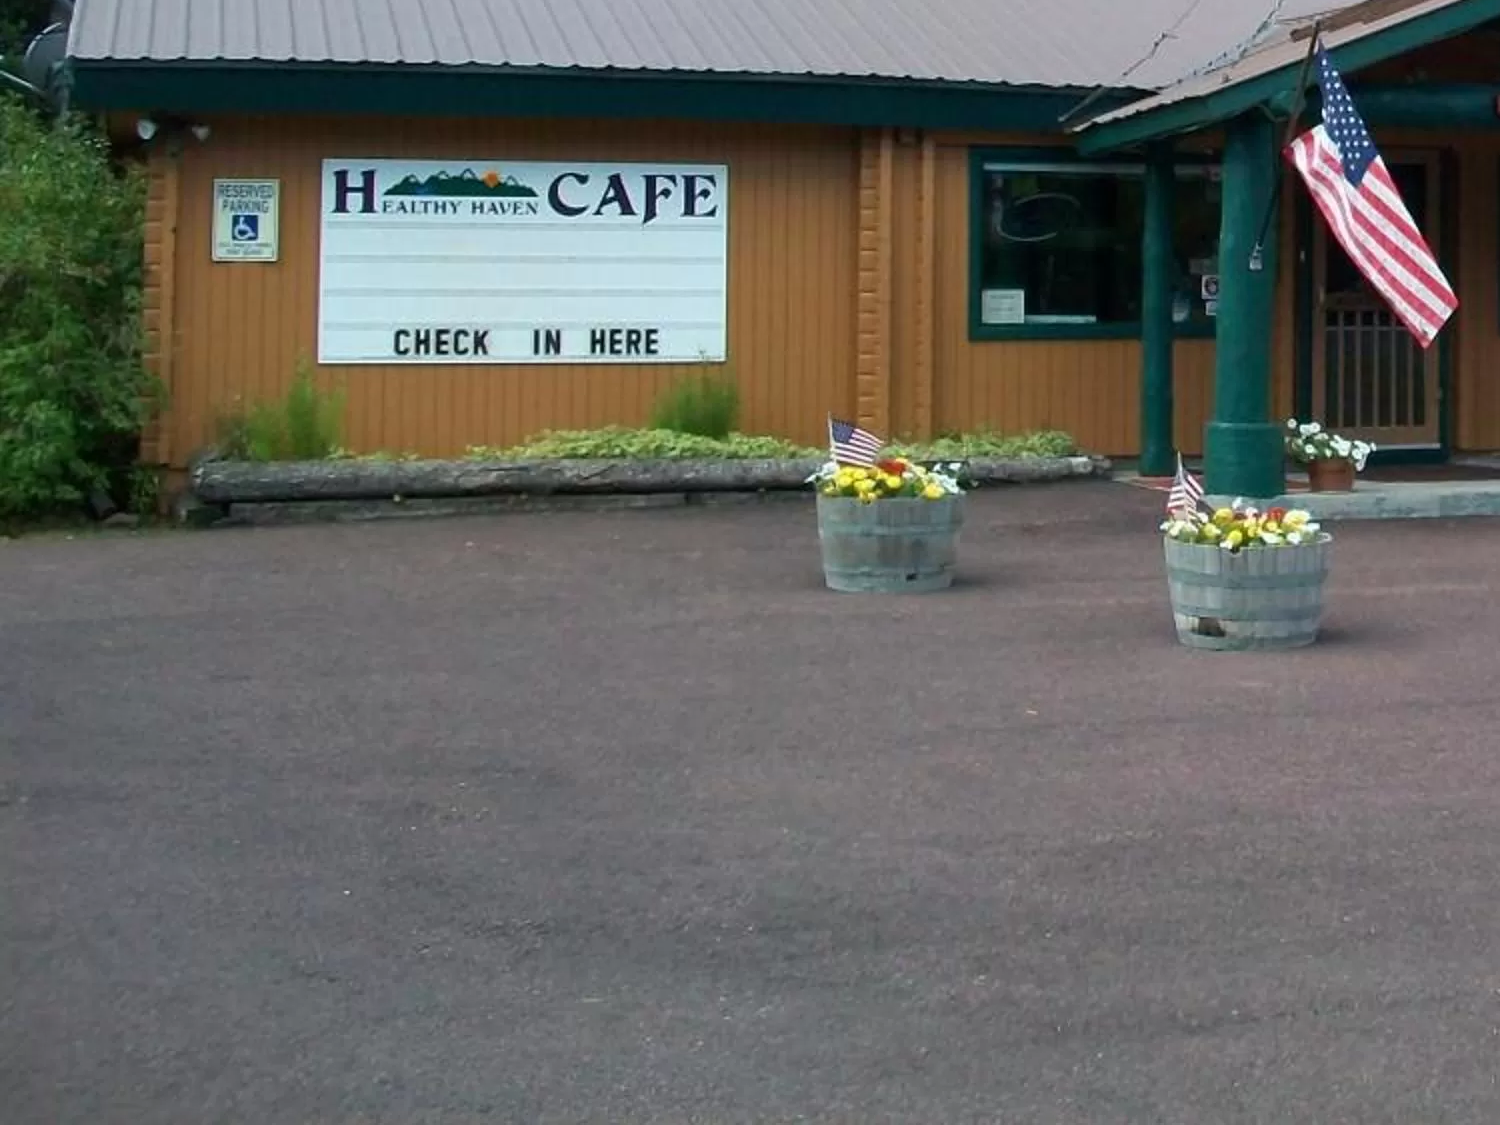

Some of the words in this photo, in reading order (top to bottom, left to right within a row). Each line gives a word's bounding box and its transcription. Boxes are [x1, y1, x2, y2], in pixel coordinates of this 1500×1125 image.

[217, 184, 274, 198] RESERVED
[471, 200, 539, 216] HAVEN
[547, 172, 718, 225] CAFE
[222, 199, 269, 213] PARKING
[393, 328, 490, 356] CHECK
[533, 328, 561, 356] IN
[589, 328, 659, 355] HERE
